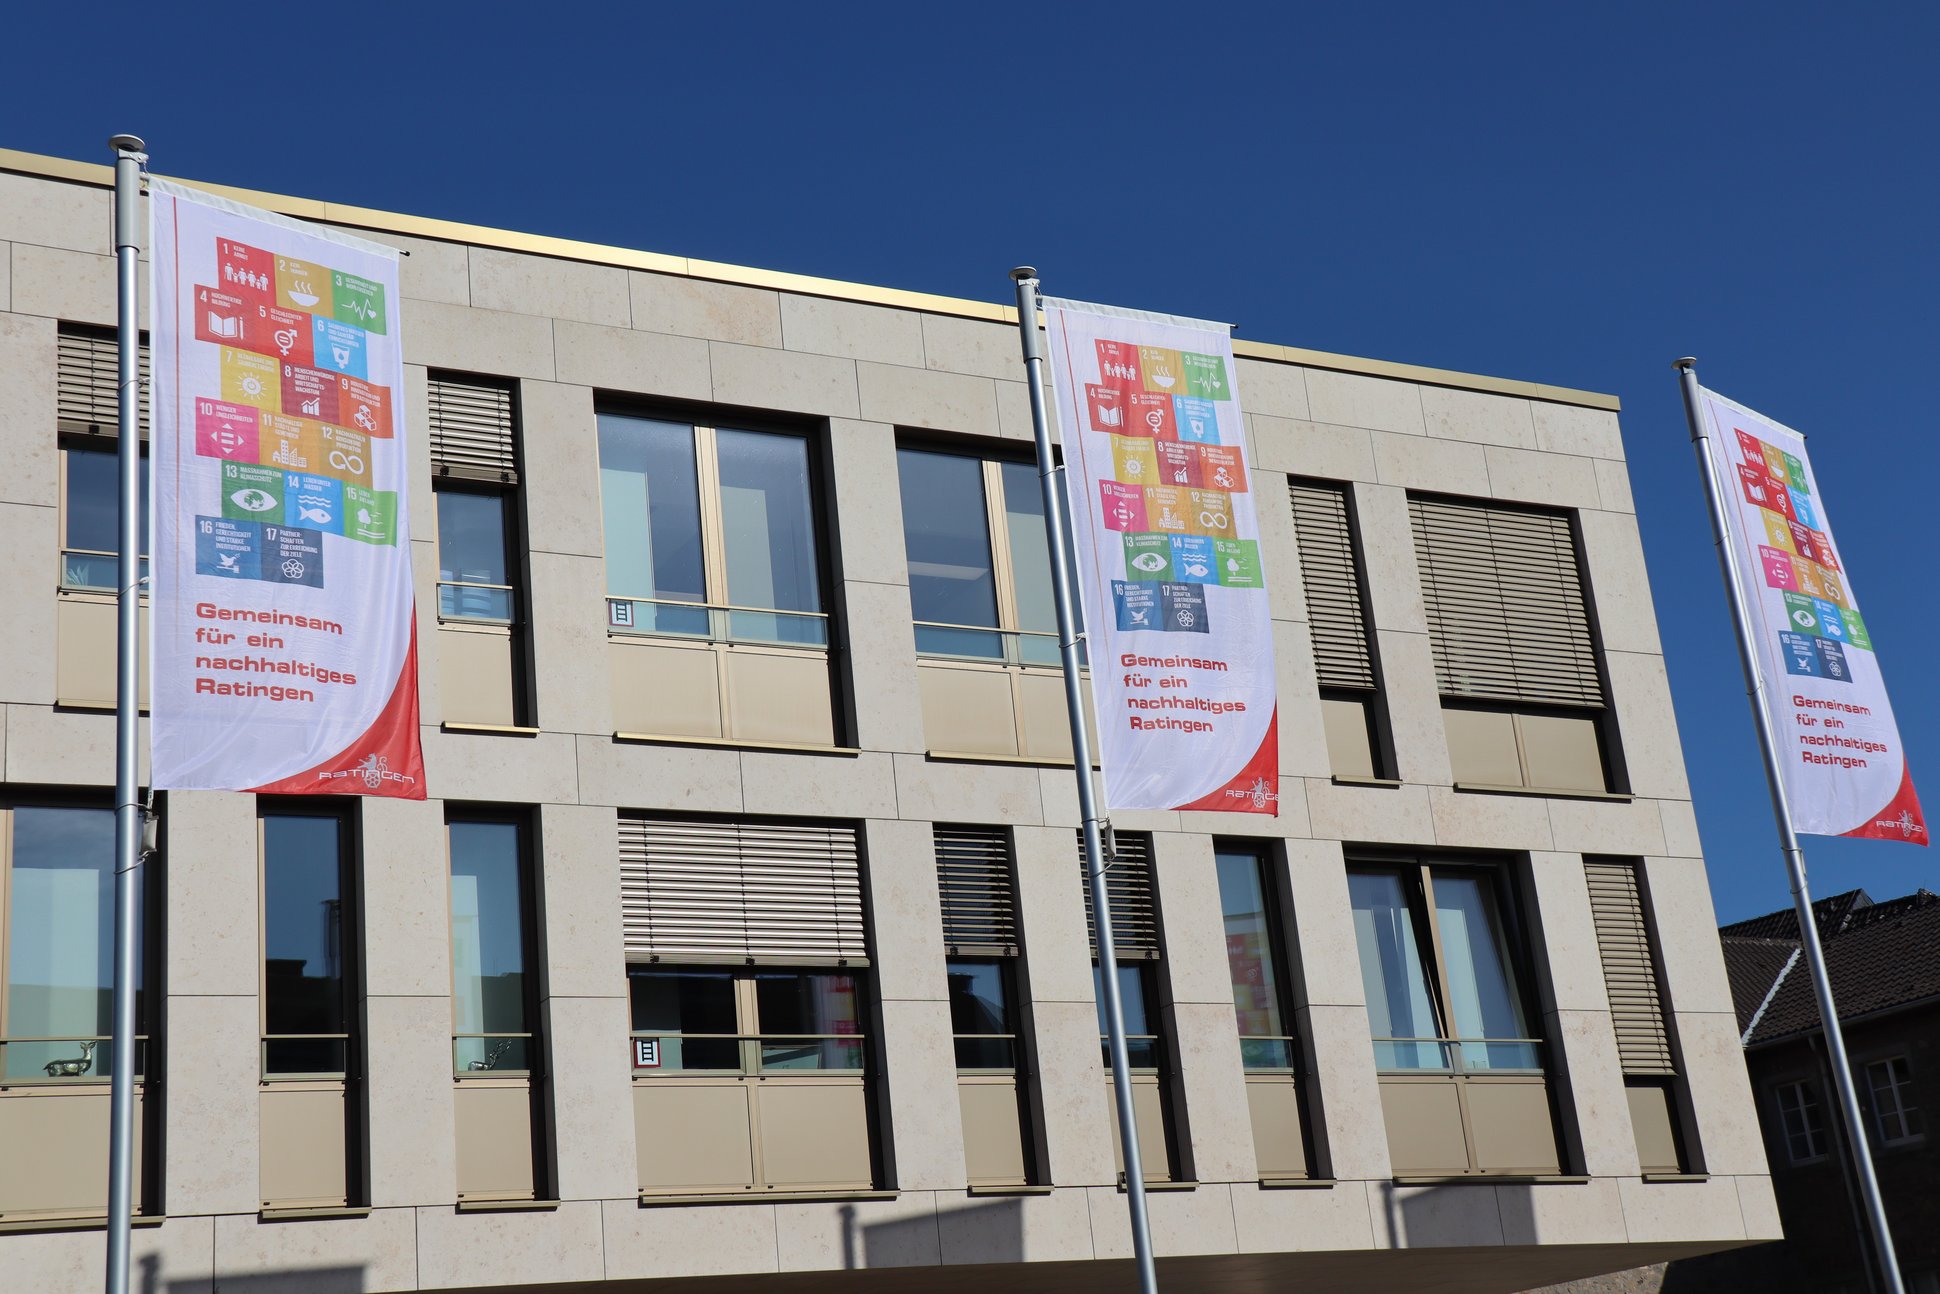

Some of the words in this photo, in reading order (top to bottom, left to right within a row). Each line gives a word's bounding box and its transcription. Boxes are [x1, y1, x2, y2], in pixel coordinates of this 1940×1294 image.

[224, 243, 229, 254] 1
[279, 259, 286, 272] 2
[336, 274, 342, 287] 3
[200, 290, 207, 303] 4
[259, 305, 266, 318] 5
[317, 319, 325, 332] 6
[1100, 343, 1105, 353] 1
[1142, 349, 1148, 360] 2
[225, 350, 233, 363] 7
[1185, 355, 1191, 365] 3
[284, 365, 292, 378] 8
[341, 378, 349, 390] 9
[1090, 388, 1096, 398] 4
[1131, 394, 1138, 404] 5
[200, 402, 213, 416] 10
[1176, 399, 1182, 409] 6
[262, 413, 273, 427] 11
[321, 426, 332, 440] 12
[1114, 437, 1119, 448] 7
[1157, 441, 1164, 452] 8
[1200, 446, 1207, 457] 9
[225, 464, 237, 478] 13
[288, 475, 299, 489] 14
[346, 486, 357, 500] 15
[1102, 483, 1112, 495] 10
[1146, 487, 1155, 498] 11
[1191, 491, 1200, 503] 12
[200, 520, 213, 534] 16
[266, 527, 277, 541] 17
[1125, 536, 1134, 548] 13
[1172, 537, 1182, 548] 14
[1216, 541, 1225, 552] 15
[1114, 583, 1124, 596] 16
[1162, 585, 1170, 597] 17
[195, 602, 343, 635] Gemeinsam
[195, 628, 236, 645] für
[247, 632, 284, 649] ein
[1120, 653, 1228, 671] Gemeinsam
[196, 656, 357, 685] nachhaltiges
[1123, 673, 1152, 688] für
[1159, 675, 1188, 688] ein
[195, 678, 314, 702] Ratingen
[1127, 696, 1246, 715] nachhaltiges
[1792, 695, 1871, 716] Gemeinsam
[1129, 716, 1214, 733] Ratingen
[1796, 713, 1818, 727] für
[1823, 716, 1845, 729] ein
[1799, 734, 1887, 753] nachhaltiges
[1802, 751, 1868, 768] Ratingen
